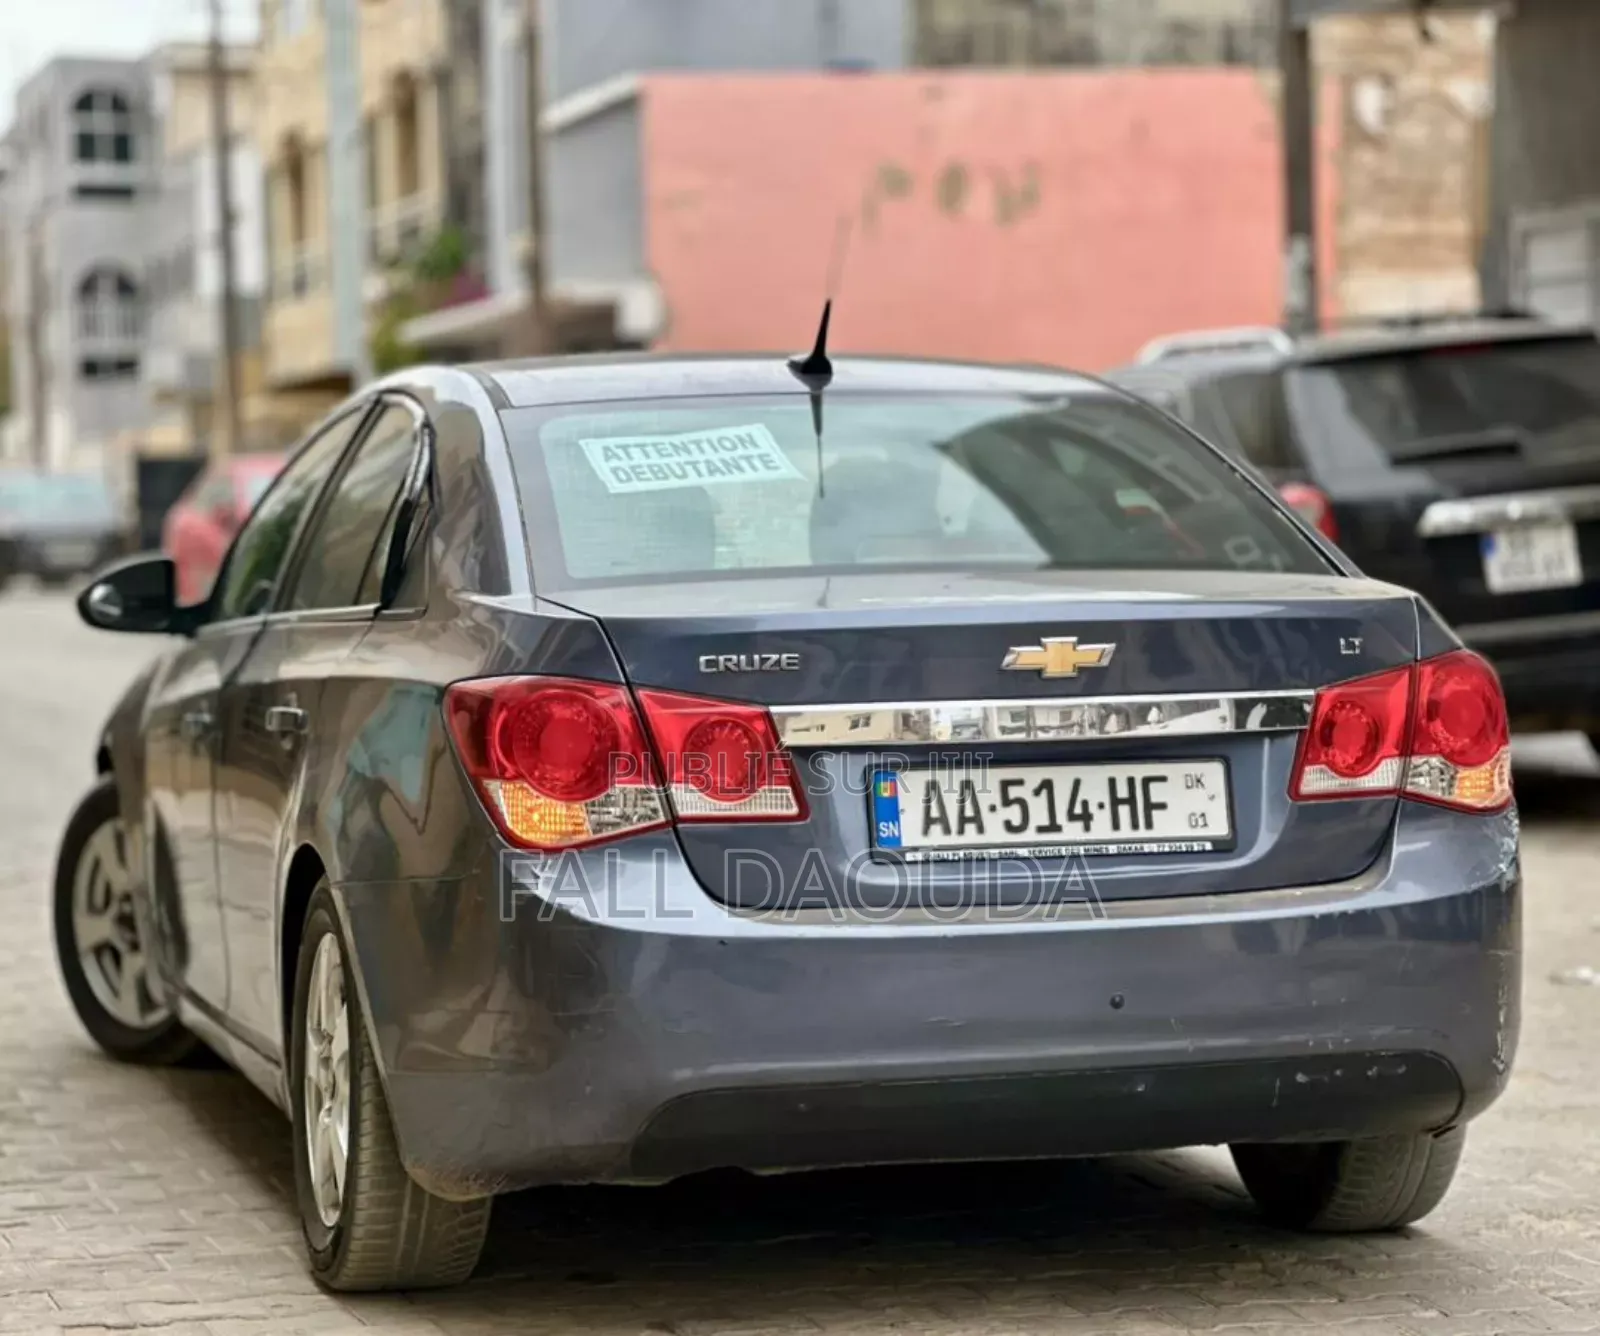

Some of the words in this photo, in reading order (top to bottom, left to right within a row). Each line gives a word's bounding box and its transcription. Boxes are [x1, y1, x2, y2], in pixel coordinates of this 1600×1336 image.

[601, 432, 760, 463] ATTENTION
[609, 453, 782, 485] DEBUTANTE
[1339, 637, 1363, 654] LT
[699, 653, 800, 673] CRUZE
[1184, 773, 1206, 790] DK
[879, 821, 899, 838] SN
